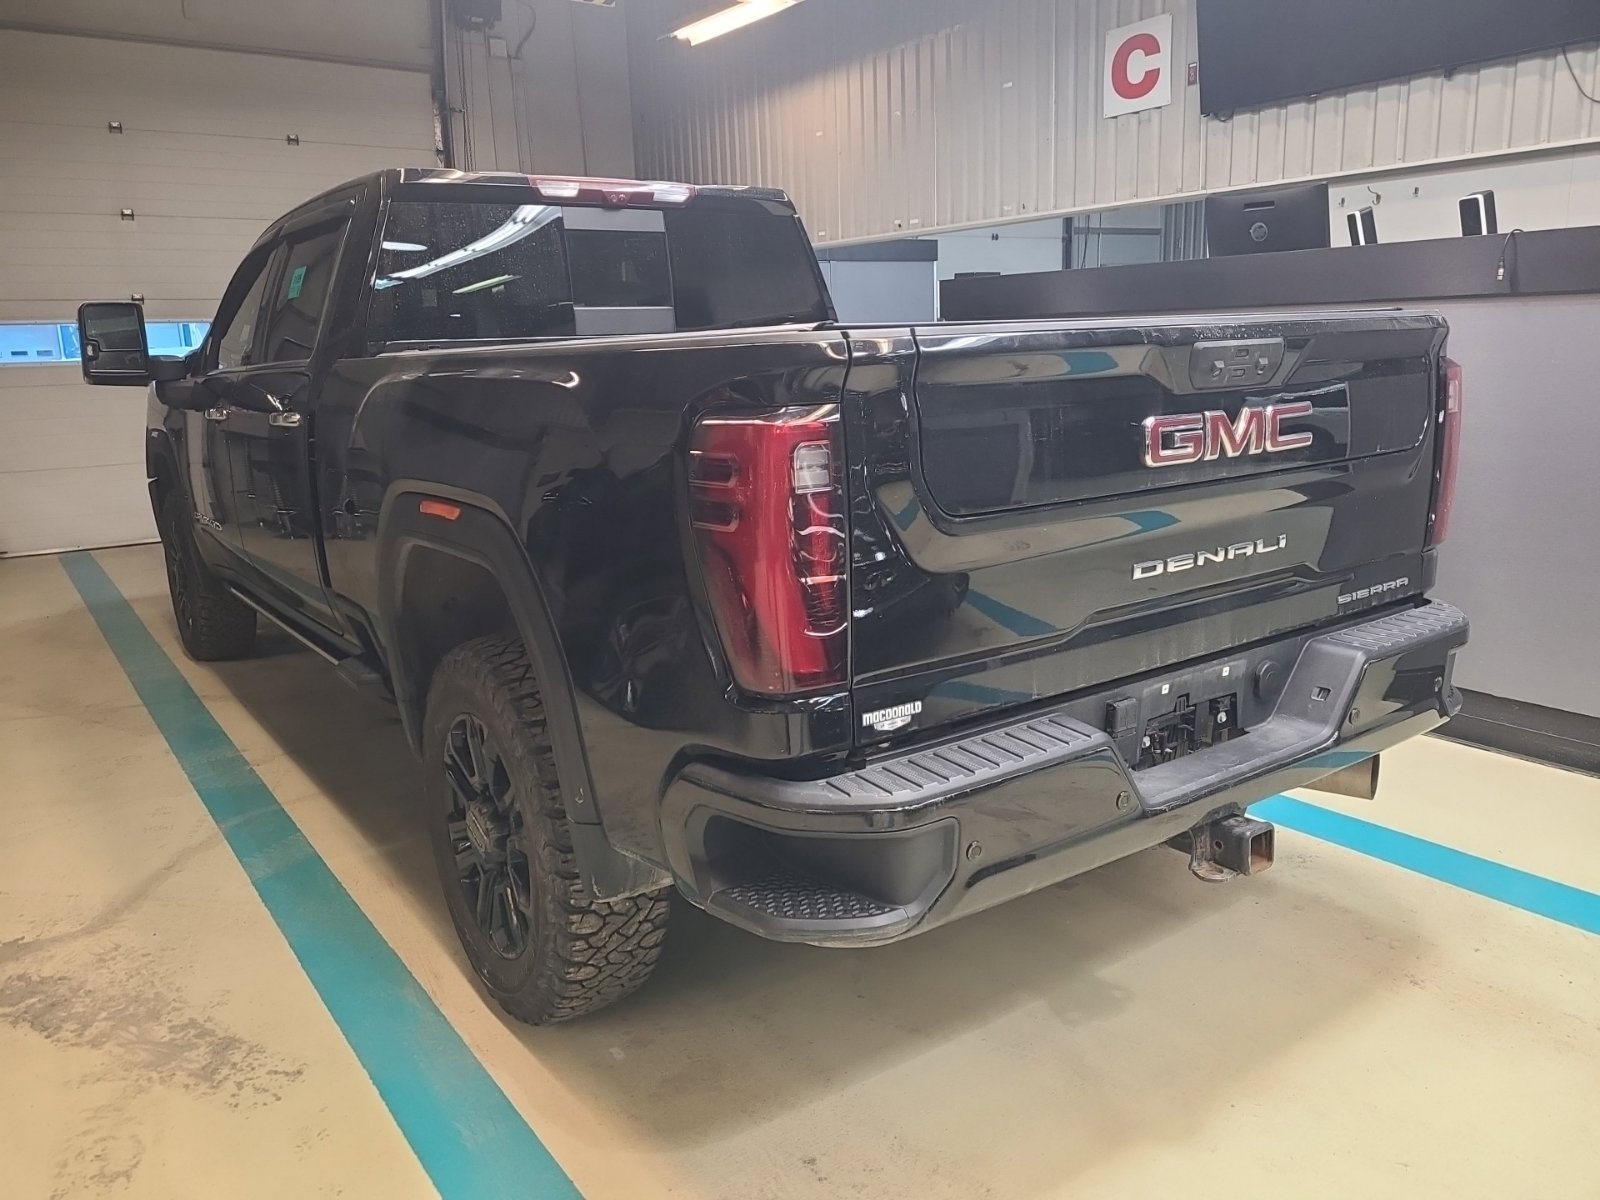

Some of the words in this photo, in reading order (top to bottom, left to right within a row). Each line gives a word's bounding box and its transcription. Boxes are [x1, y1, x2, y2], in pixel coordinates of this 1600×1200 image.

[1111, 33, 1161, 99] C
[1142, 401, 1313, 468] GMC
[1132, 533, 1287, 580] DENALI
[1337, 577, 1409, 605] SIERRA
